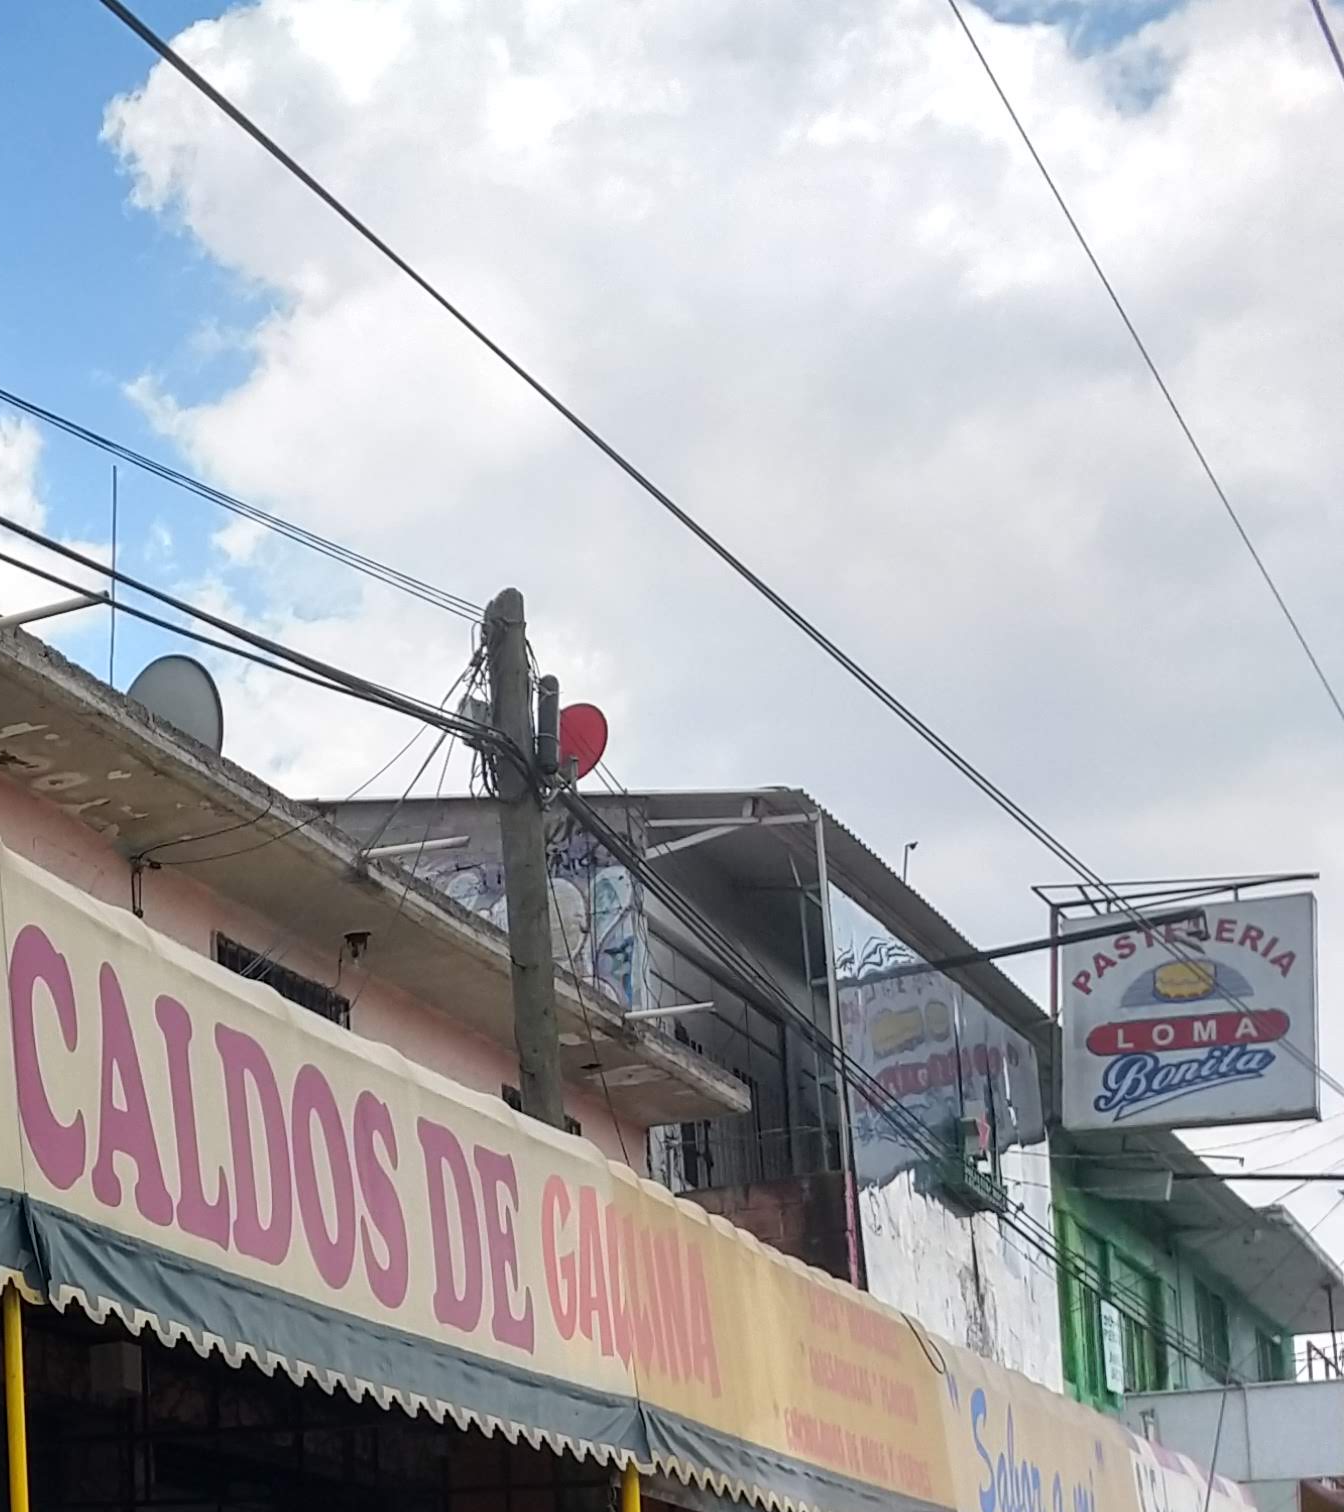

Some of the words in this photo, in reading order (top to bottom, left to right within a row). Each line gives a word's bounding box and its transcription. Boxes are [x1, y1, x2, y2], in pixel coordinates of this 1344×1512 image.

[1117, 1017, 1258, 1049] LOMA
[1094, 1042, 1276, 1113] Bonita
[9, 924, 409, 1310] CALDOS
[417, 1116, 535, 1354] DE
[541, 1174, 722, 1398] GALLINA
